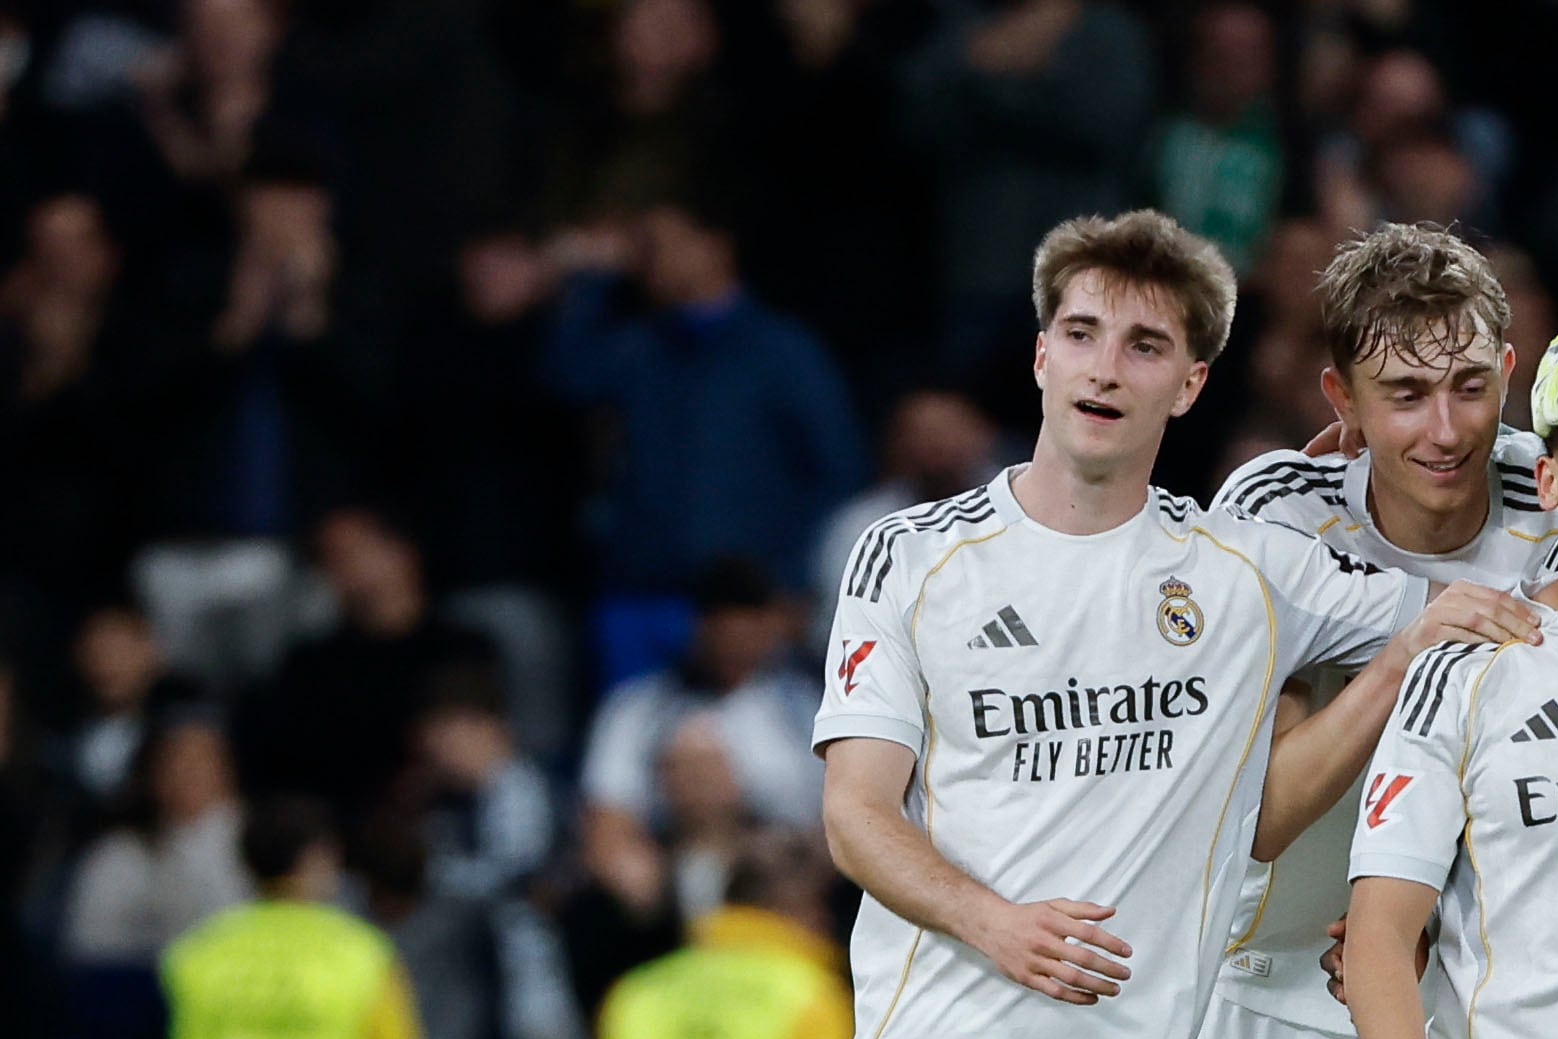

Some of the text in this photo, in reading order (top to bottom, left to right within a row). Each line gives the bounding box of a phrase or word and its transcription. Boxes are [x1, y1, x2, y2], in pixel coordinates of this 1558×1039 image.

[967, 675, 1210, 739] Emirates
[1012, 729, 1174, 782] FLY BETTER
